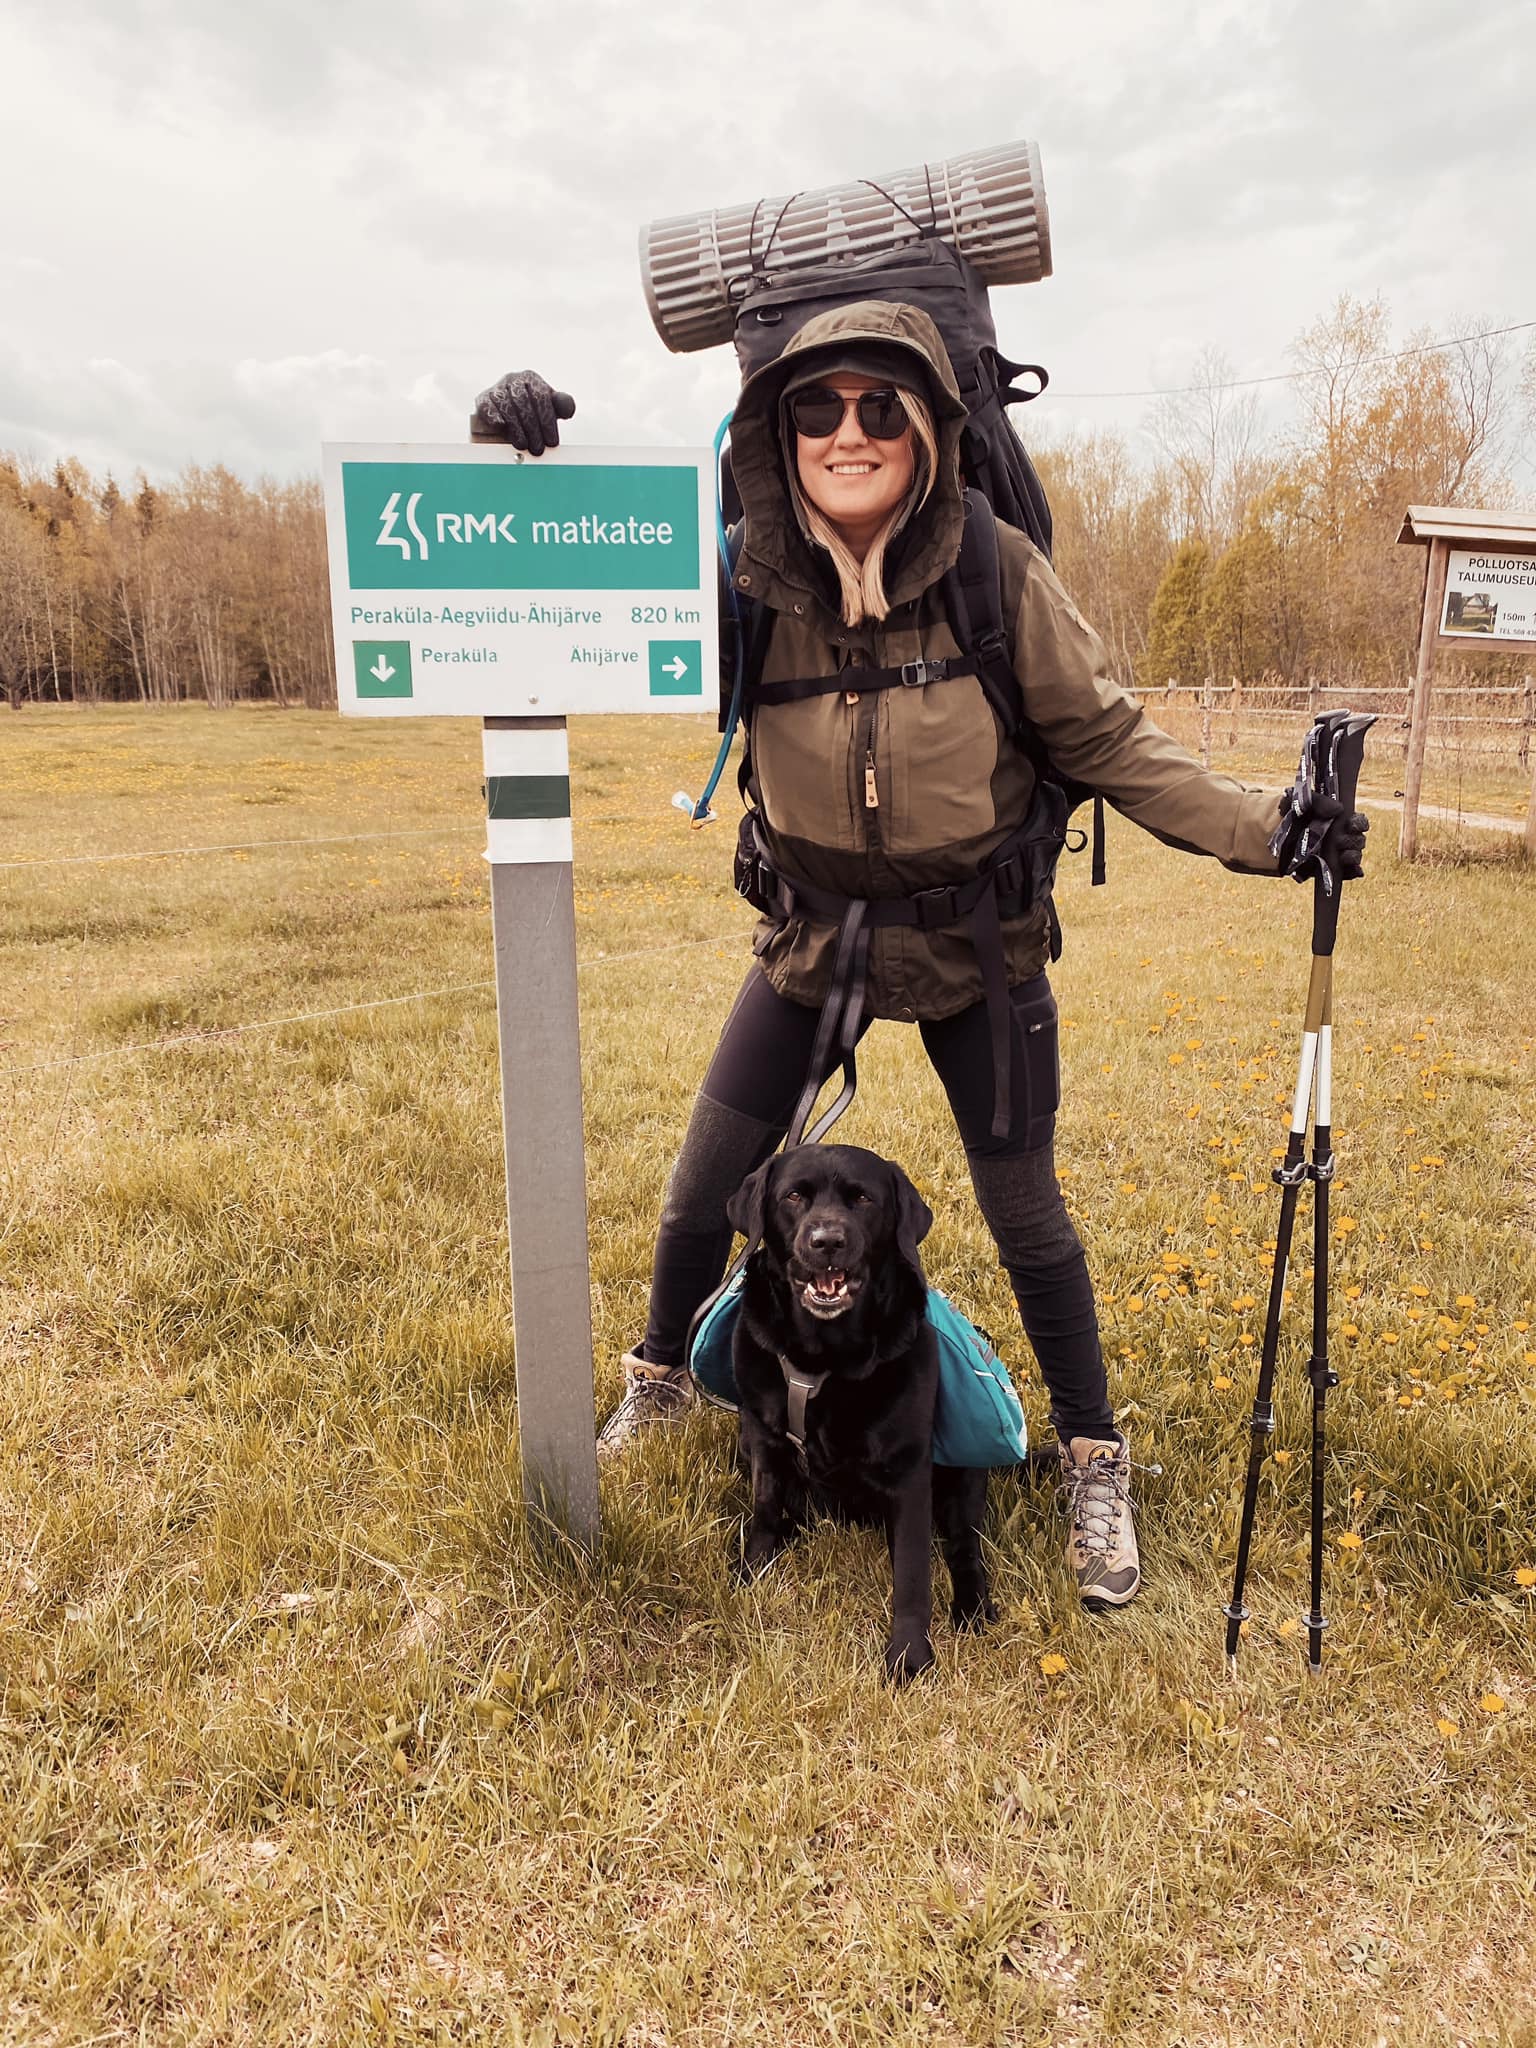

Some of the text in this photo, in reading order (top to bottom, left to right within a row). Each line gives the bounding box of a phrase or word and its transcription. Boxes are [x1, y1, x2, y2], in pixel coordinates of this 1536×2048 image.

[436, 513, 673, 545] RMK matkatee
[1458, 571, 1536, 586] TALUMUUSEU
[351, 603, 700, 627] Peraküla-Aegviidu-Ähijärve 820 km
[421, 648, 498, 664] Peraküla
[570, 647, 639, 667] Ähijärve
